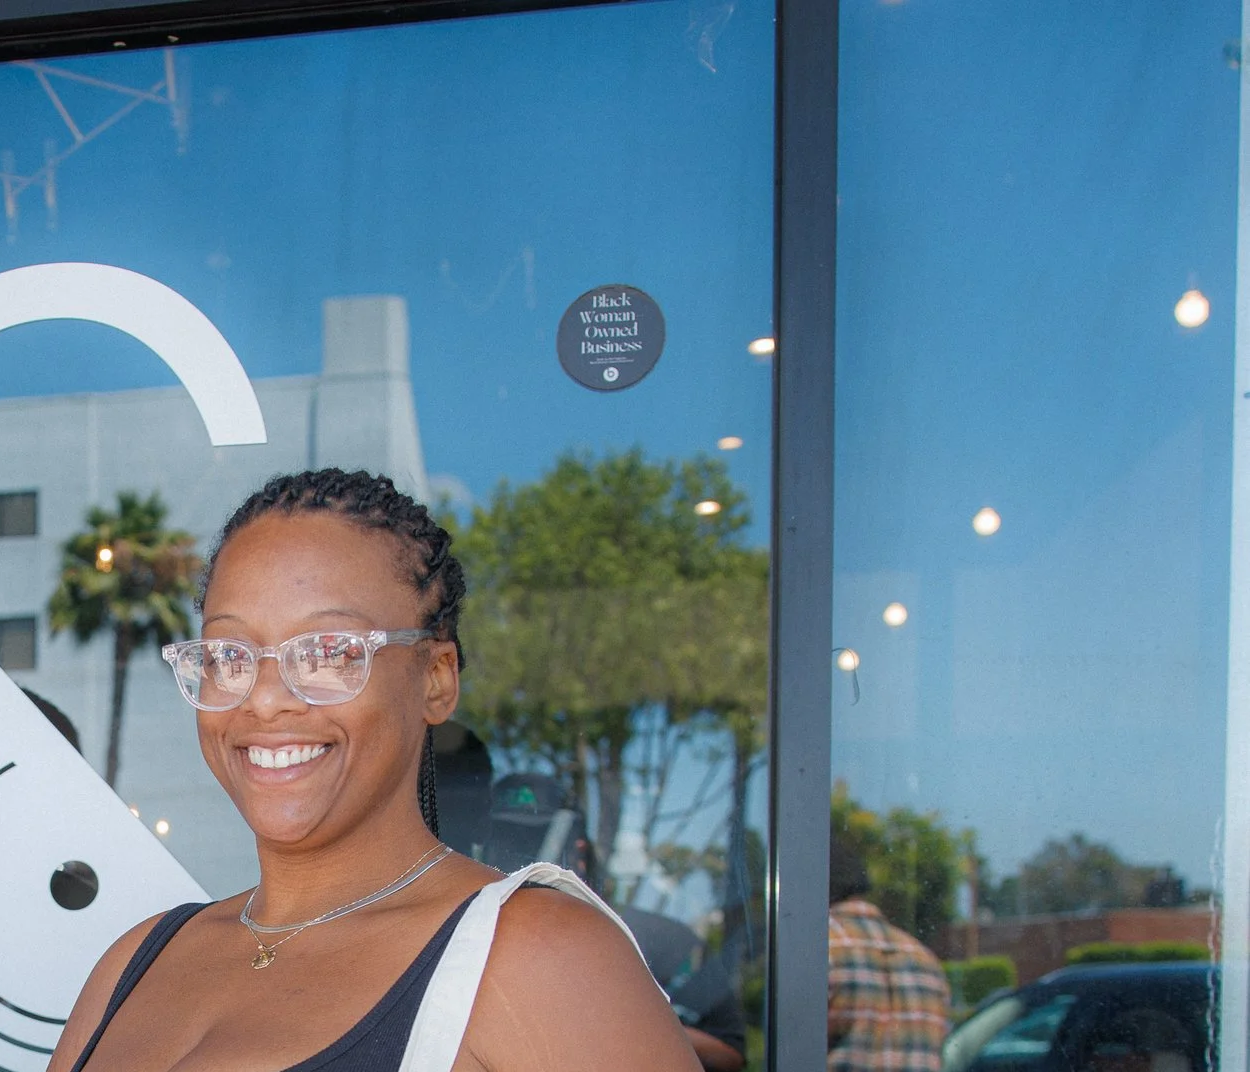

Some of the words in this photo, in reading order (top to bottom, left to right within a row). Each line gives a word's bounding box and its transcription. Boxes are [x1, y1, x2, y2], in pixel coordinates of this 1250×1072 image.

[592, 292, 632, 308] Black
[579, 310, 636, 324] Woman
[584, 321, 638, 338] Owned
[581, 340, 643, 354] Business
